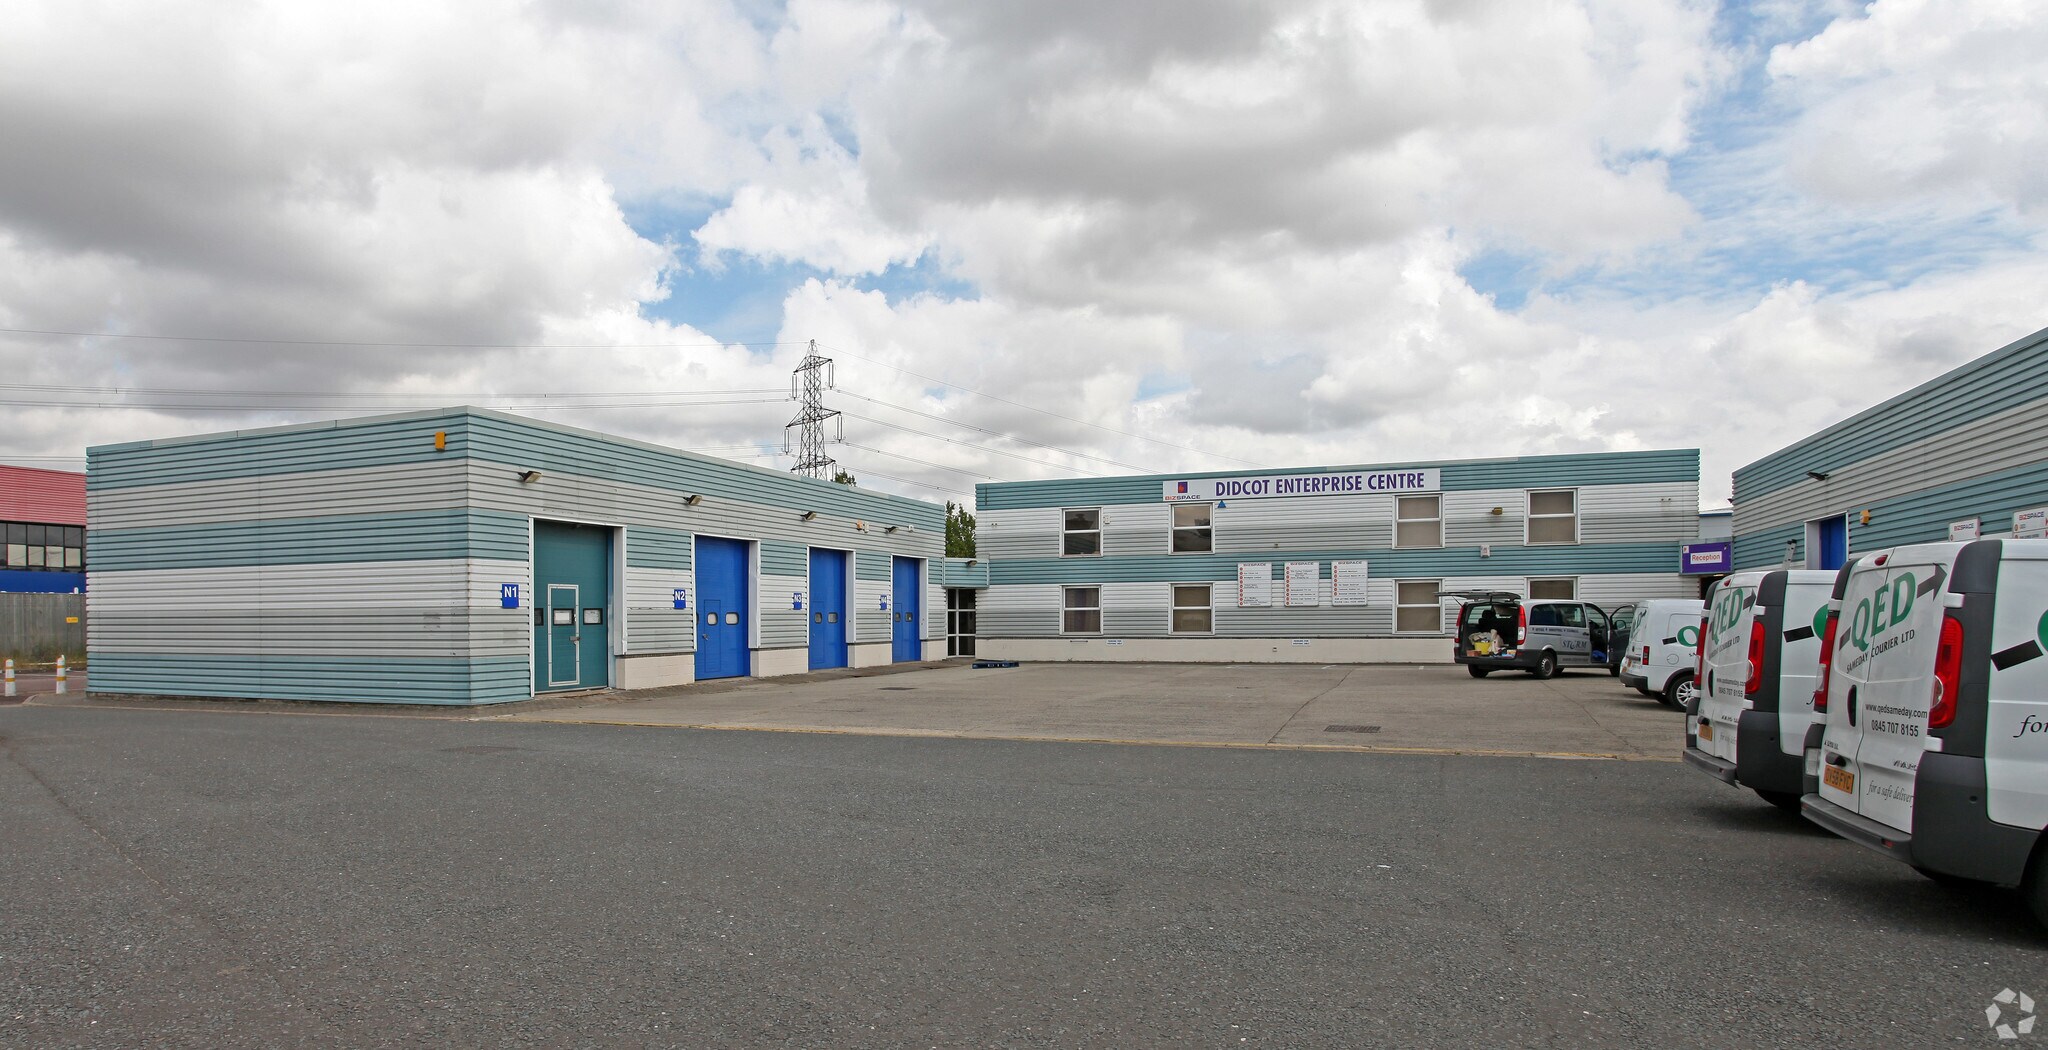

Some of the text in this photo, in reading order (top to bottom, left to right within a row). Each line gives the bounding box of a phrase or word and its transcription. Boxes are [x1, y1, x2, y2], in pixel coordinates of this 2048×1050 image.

[1215, 472, 1425, 496] DIDCOT ENTERPRISE CENTRE
[2018, 511, 2045, 521] BIZSPACE
[1953, 522, 1974, 532] BIZSPACE
[1691, 554, 1721, 562] Reception
[504, 586, 517, 598] N1
[674, 591, 685, 601] N2
[1711, 588, 1744, 646] QED
[1851, 571, 1917, 652] QED
[1846, 629, 1915, 674] SAMEDAY COURIER LTD
[1865, 704, 1928, 719] www.qedsameday.com
[1871, 719, 1919, 737] 0845 707 8155
[1866, 780, 1877, 796] for
[1881, 785, 1892, 801] safe
